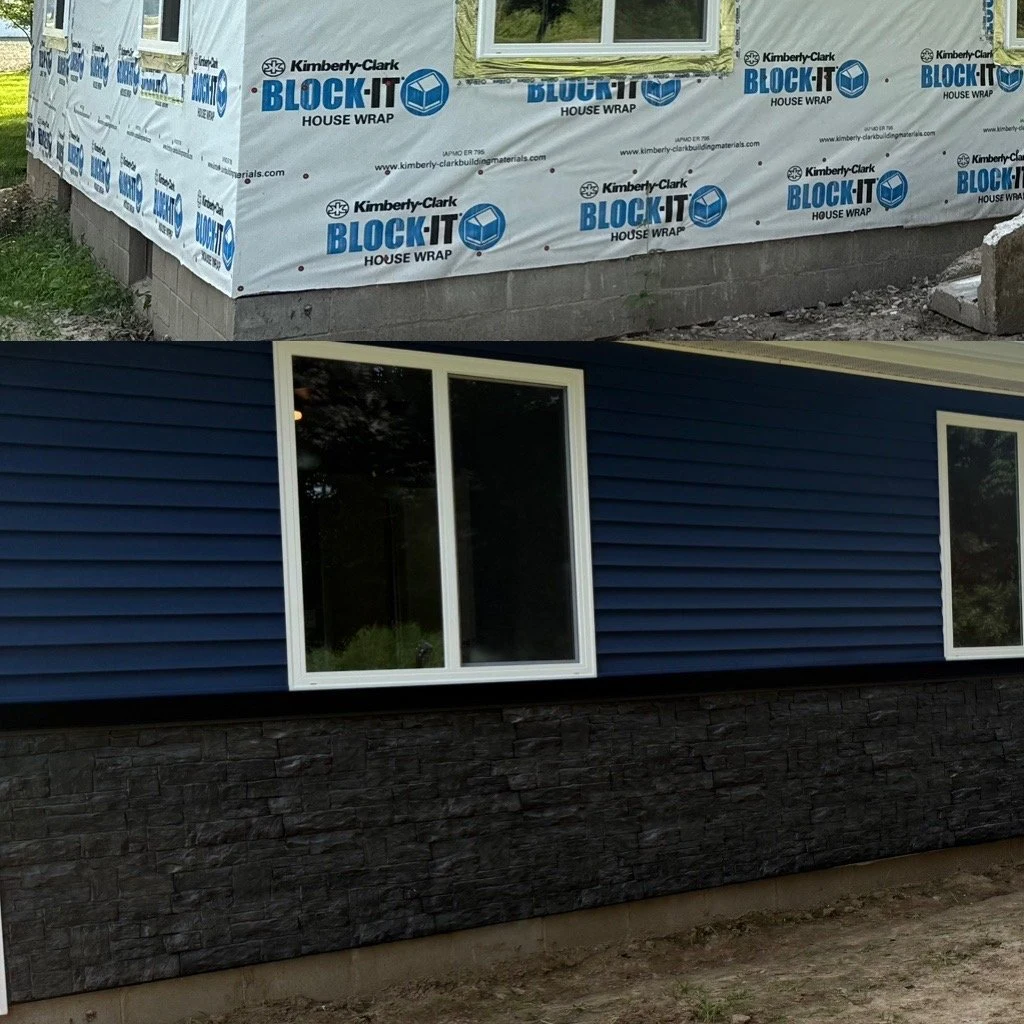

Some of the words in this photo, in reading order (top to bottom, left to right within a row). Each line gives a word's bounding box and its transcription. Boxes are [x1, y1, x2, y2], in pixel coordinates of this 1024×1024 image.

[762, 52, 835, 65] Kimberly-Clark
[290, 59, 400, 75] Kimberly-Clark
[744, 66, 836, 95] BLOCK-IT
[921, 63, 996, 89] BLOCK-IT
[261, 77, 402, 112] BLOCK-IT
[770, 97, 803, 107] HOUSE
[805, 95, 832, 105] WRAP
[943, 90, 972, 100] HOUSE
[974, 89, 993, 98] WRAP
[560, 106, 600, 117] HOUSE
[602, 104, 637, 115] WRAP
[302, 115, 351, 127] HOUSE
[354, 113, 394, 125] WRAP
[805, 164, 876, 177] Kimberly-Clark
[602, 179, 688, 195] Kimberly-Clark
[787, 177, 877, 211] BLOCK-IT
[354, 196, 458, 214] Kimberly-Clark
[978, 194, 1006, 204] HOUSE
[580, 194, 689, 231] BLOCK-IT
[812, 210, 844, 221] HOUSE
[846, 207, 871, 218] WRAP
[326, 214, 459, 255] BLOCK-IT
[611, 229, 649, 242] HOUSE
[651, 226, 682, 238] WRAP
[364, 253, 411, 267] HOUSE
[414, 249, 452, 263] WRAP
